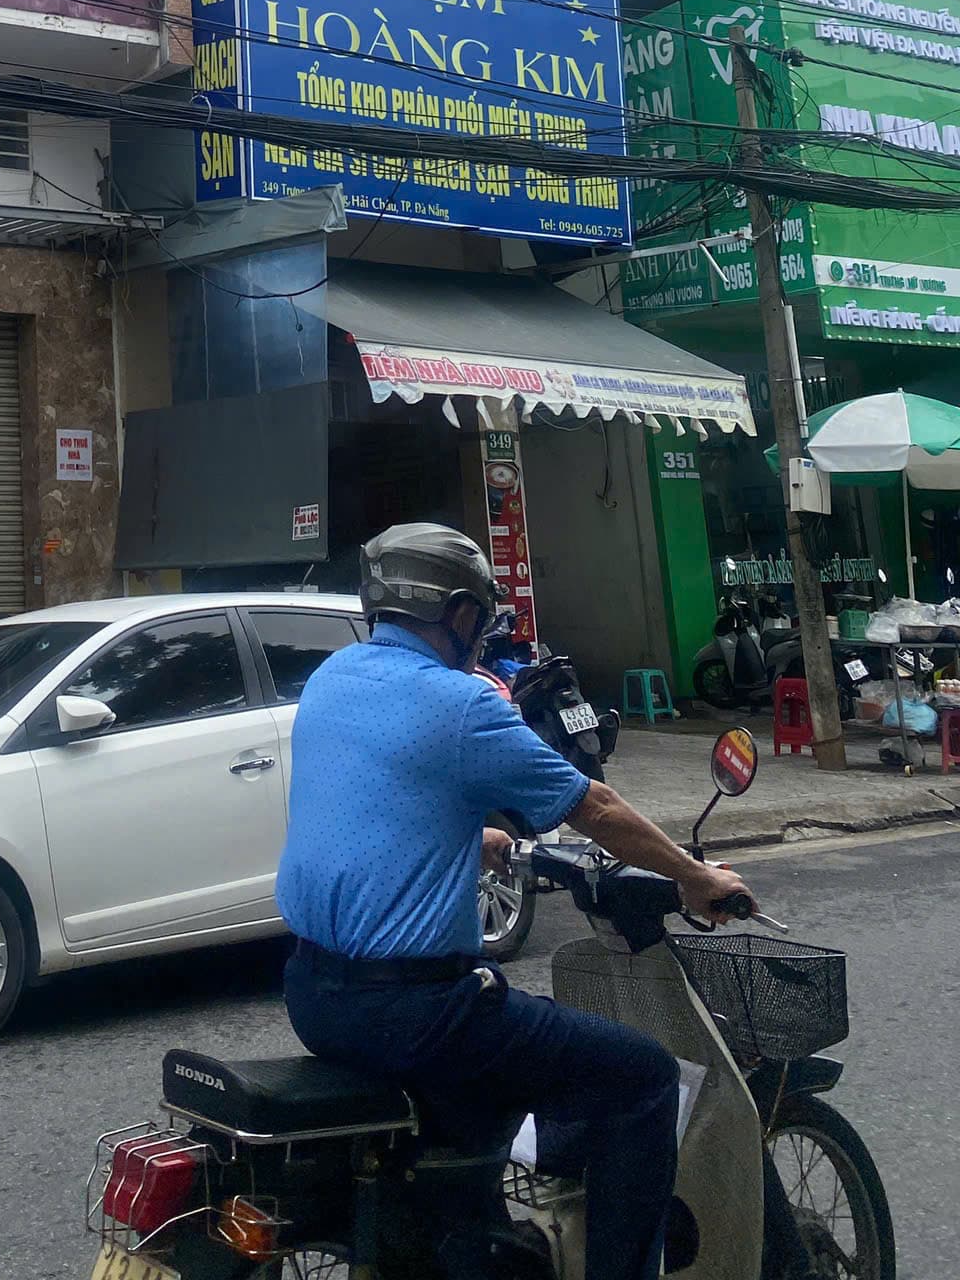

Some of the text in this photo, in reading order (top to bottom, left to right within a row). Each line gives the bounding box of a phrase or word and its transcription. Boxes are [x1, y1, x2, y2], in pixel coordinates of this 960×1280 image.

[265, 0, 608, 104] HOÀNG KIM
[623, 31, 674, 79] ĂNG
[816, 18, 956, 62] BỆNH VIỆN ĐA KHOA
[194, 31, 236, 93] KHÁCH
[297, 60, 346, 114] TỔNG
[351, 79, 387, 121] KHO
[391, 86, 441, 131] PHÂN
[444, 91, 485, 137] PHỐI
[820, 104, 876, 137] NHA
[201, 132, 234, 191] SẠN
[262, 181, 279, 195] 349
[475, 164, 511, 203] SẠN
[352, 194, 370, 210] Hải
[401, 201, 413, 214] TP.
[414, 203, 427, 216] Đà
[427, 202, 451, 221] Nẵng
[539, 218, 557, 232] Tel:
[559, 221, 625, 239] 0949.605.725
[625, 255, 659, 283] ANH
[851, 261, 878, 285] 351
[361, 348, 418, 385] TIỆM
[413, 357, 466, 385] NHÀ
[461, 363, 506, 389] MIU
[503, 367, 545, 394] MIU
[489, 433, 512, 449] 349
[663, 451, 695, 469] 351
[174, 1063, 226, 1092] HONDA
